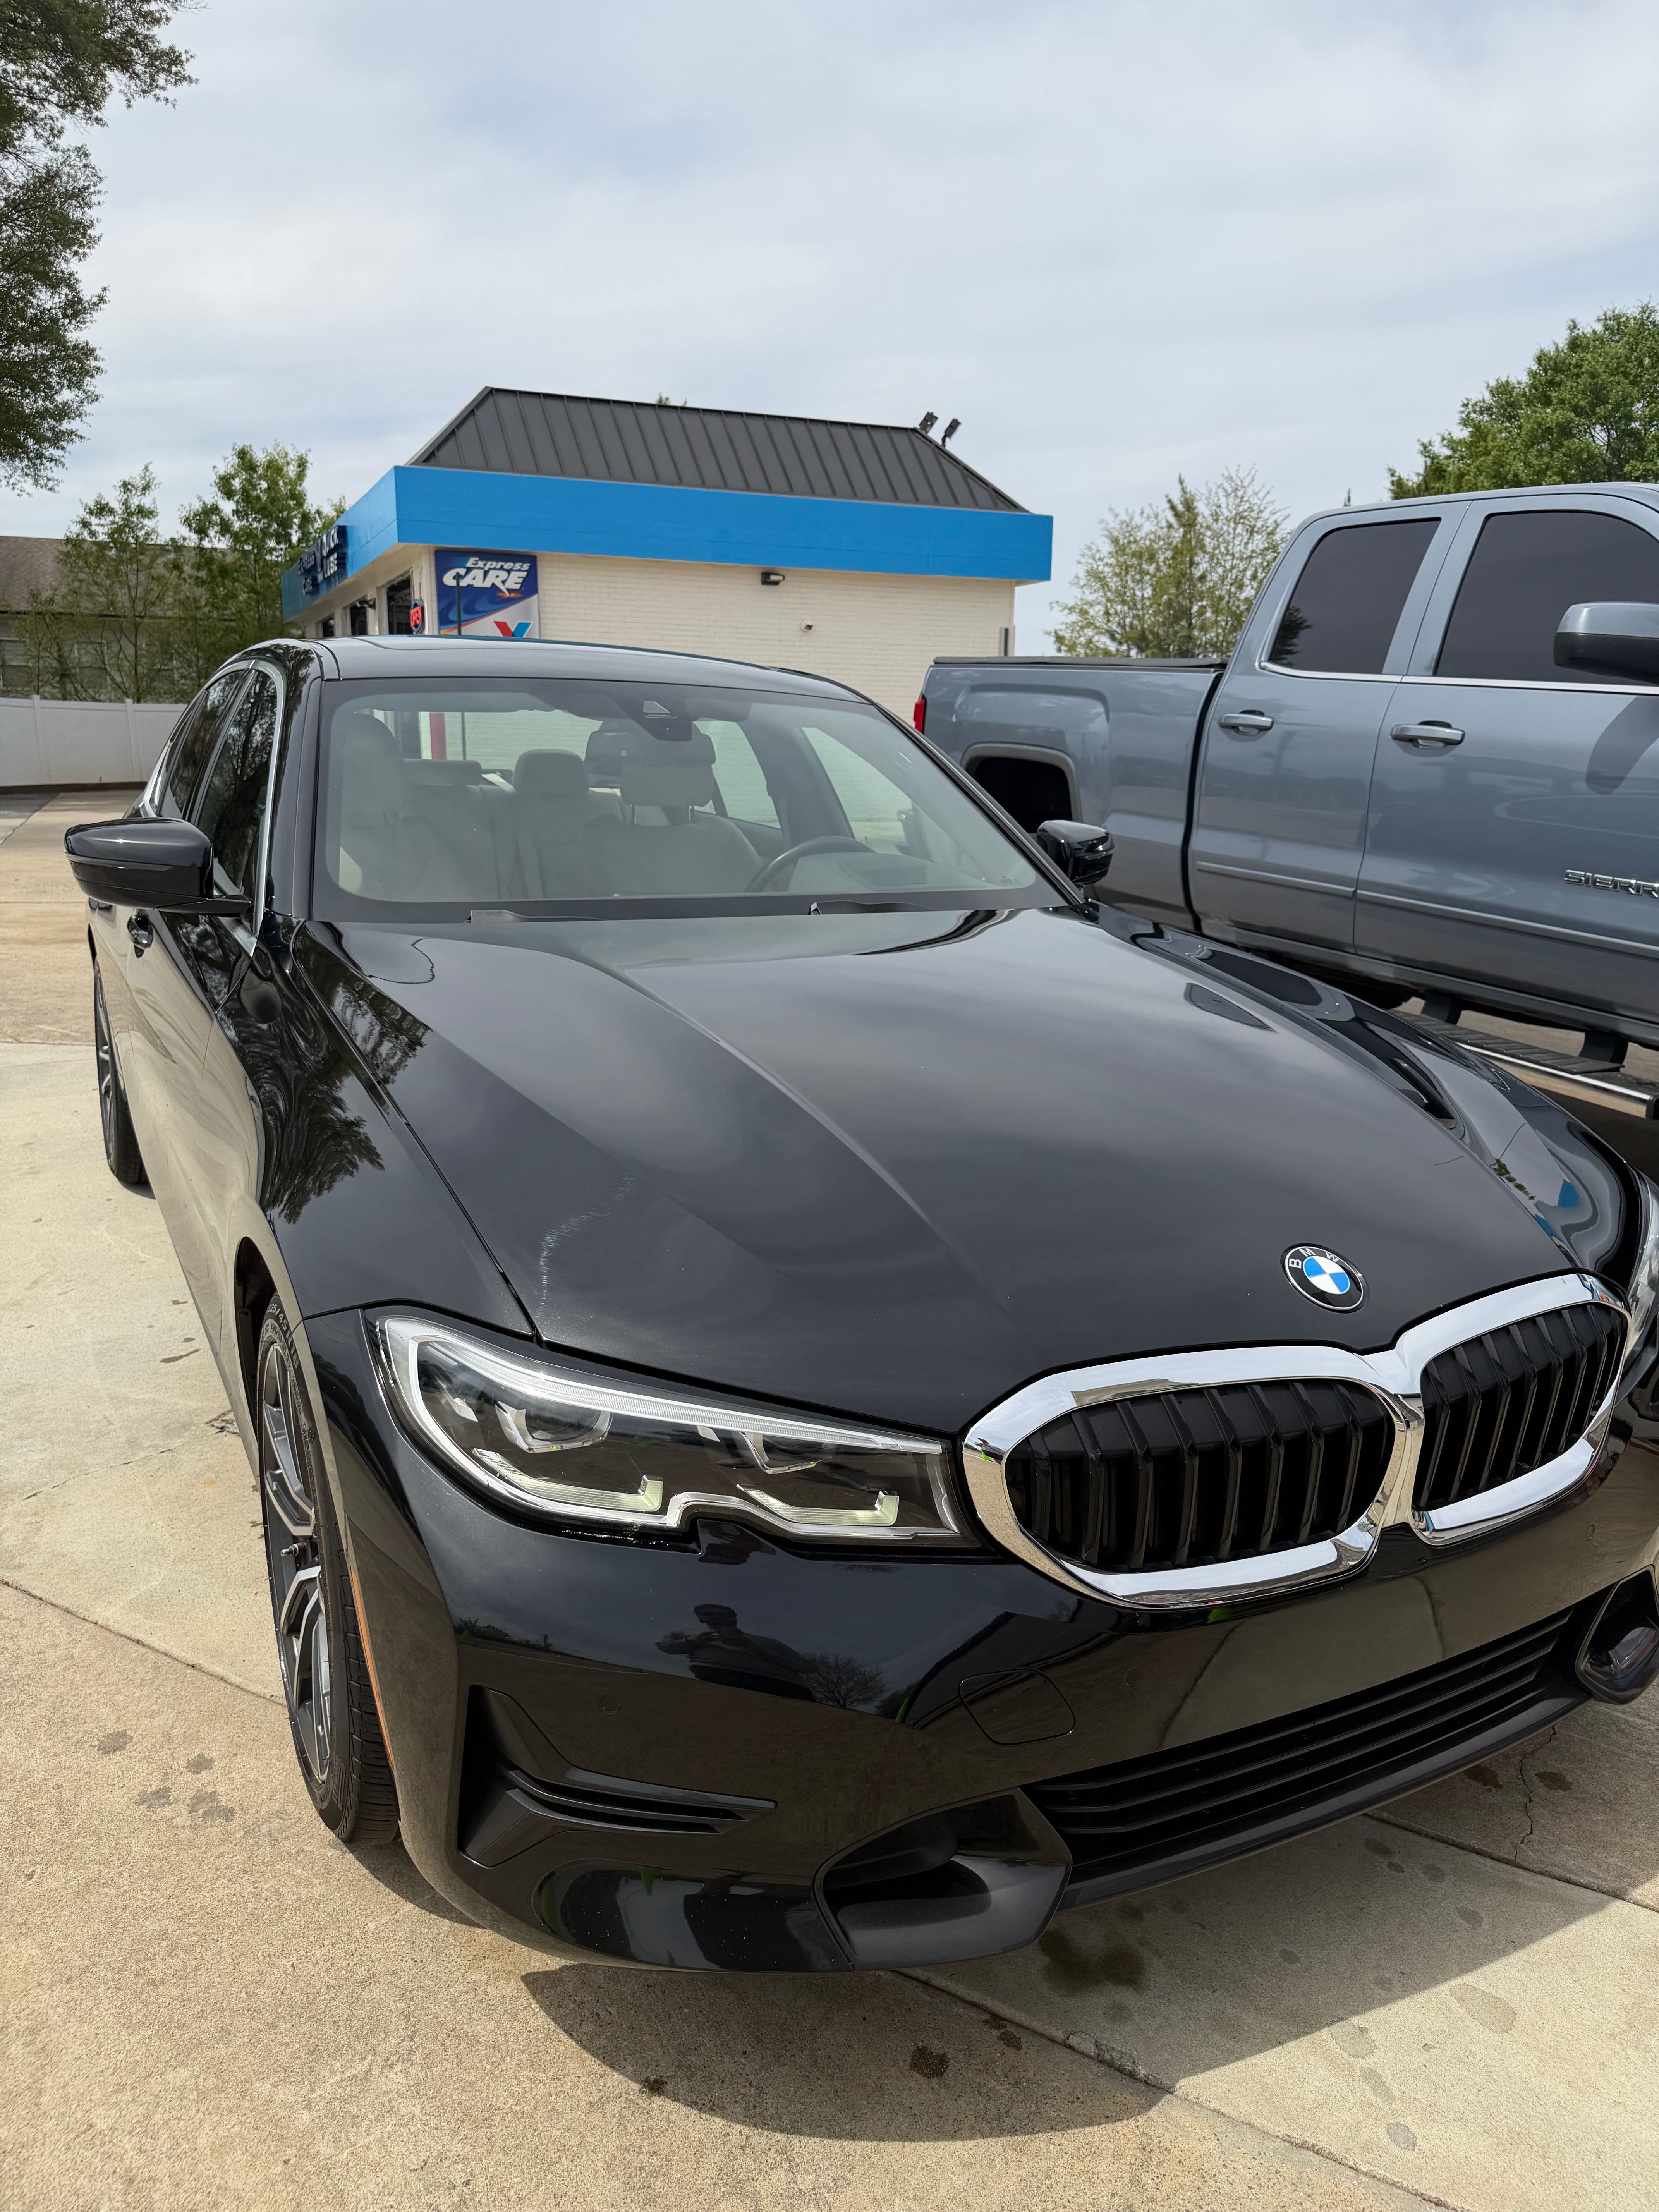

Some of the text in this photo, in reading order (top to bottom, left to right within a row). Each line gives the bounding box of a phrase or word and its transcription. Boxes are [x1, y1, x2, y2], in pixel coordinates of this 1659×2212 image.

[465, 557, 531, 571] Express
[442, 568, 528, 595] CARE
[1289, 1248, 1340, 1269] BMW
